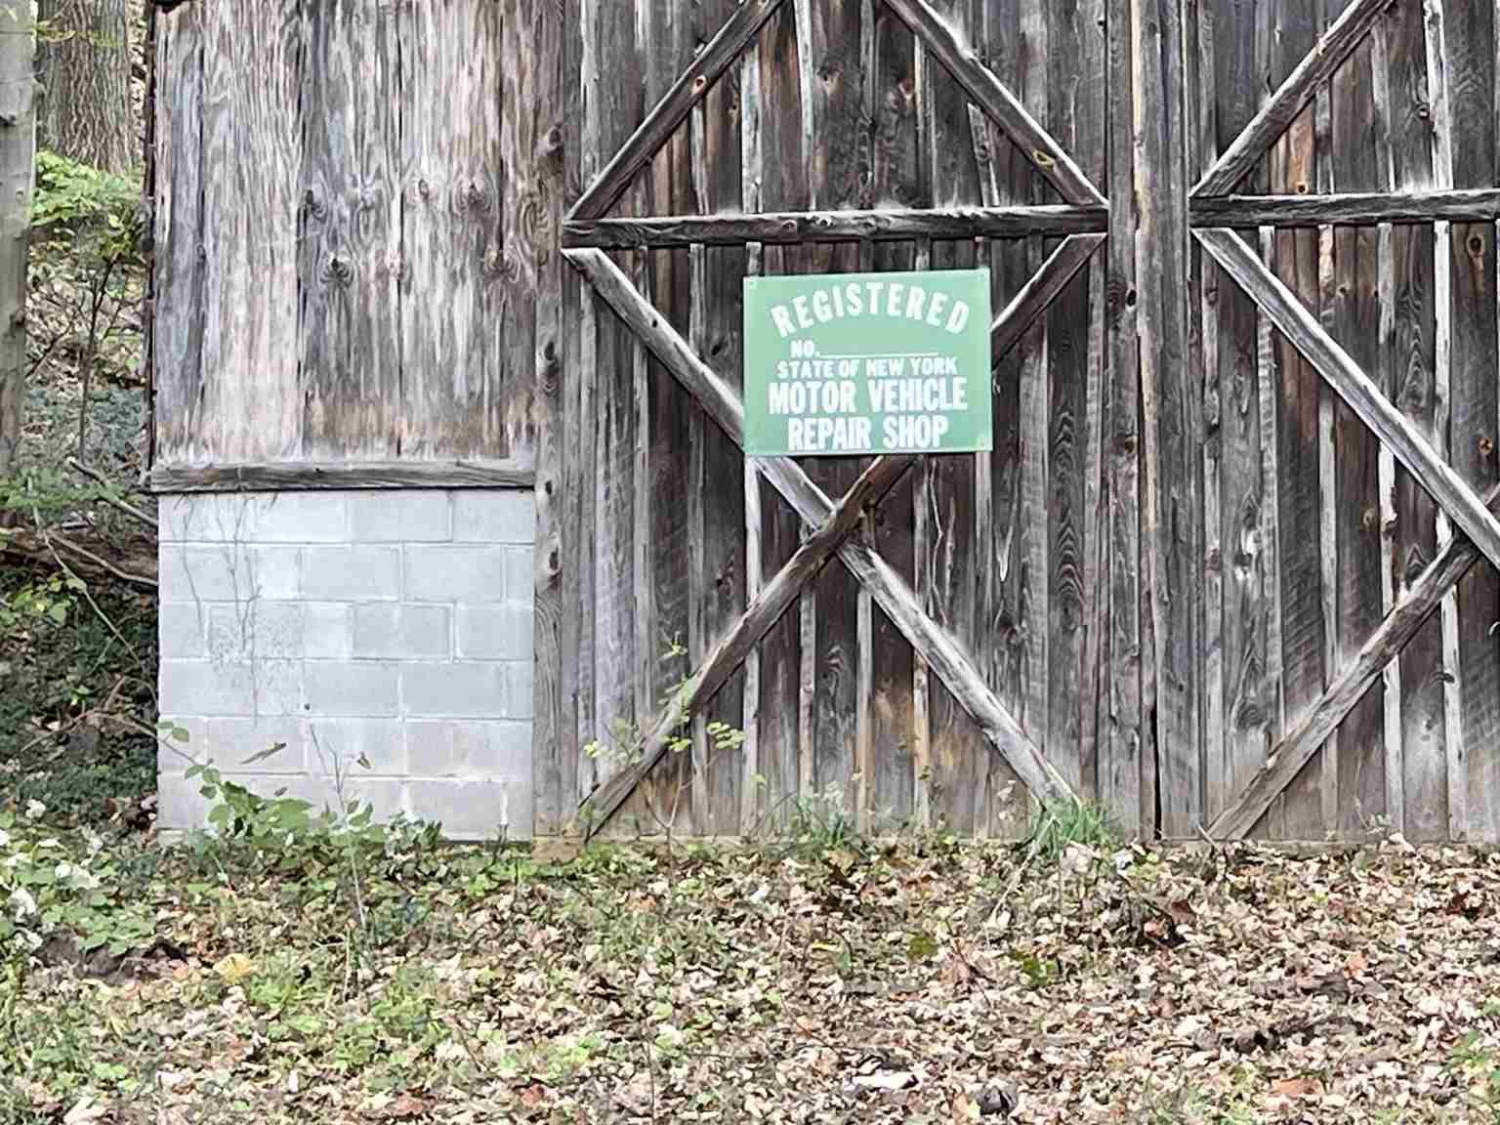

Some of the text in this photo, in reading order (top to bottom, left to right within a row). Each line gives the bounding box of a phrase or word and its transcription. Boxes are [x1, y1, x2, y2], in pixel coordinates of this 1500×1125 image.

[771, 282, 969, 337] REGISTERED
[790, 340, 820, 358] NO.
[777, 357, 957, 379] STATE OF NEW YORK
[768, 377, 968, 415] MOTOR VEHICLE
[788, 415, 949, 450] REPAIR SHOP
